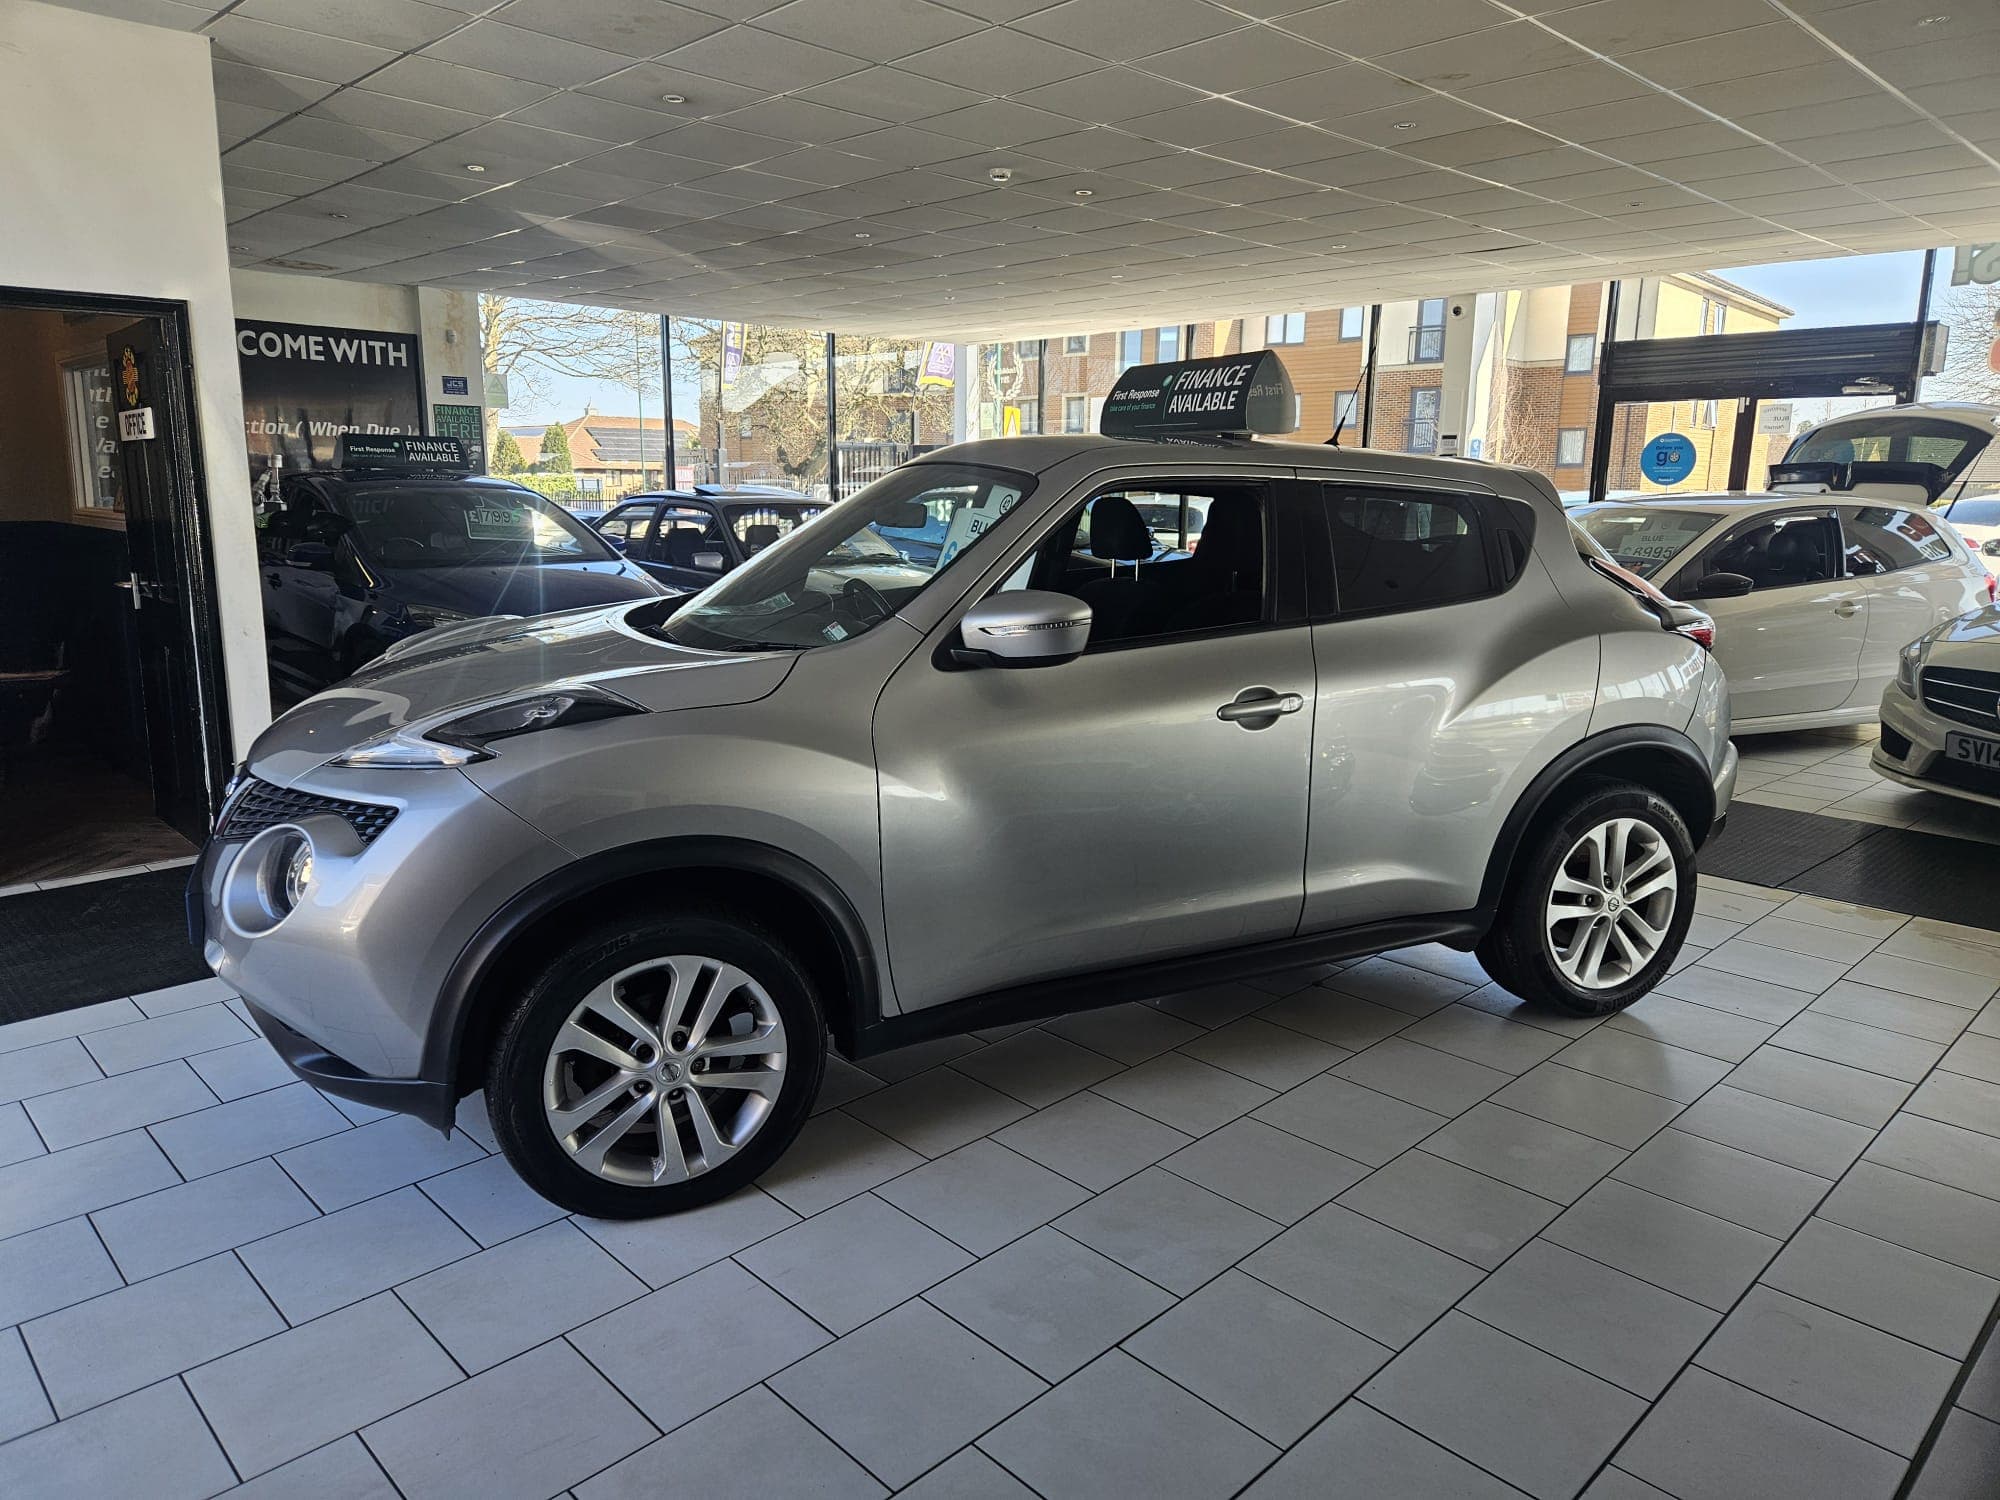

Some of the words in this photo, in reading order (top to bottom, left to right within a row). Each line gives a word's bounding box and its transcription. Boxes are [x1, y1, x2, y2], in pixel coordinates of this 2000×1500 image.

[237, 330, 325, 361] COME
[328, 337, 408, 367] WITH
[1174, 364, 1252, 391] FINANCE
[1113, 390, 1128, 401] First
[1128, 388, 1160, 401] Response
[1168, 390, 1239, 413] AVAILABLE
[435, 406, 479, 416] FINANCE
[124, 412, 147, 436] OFFICE
[435, 415, 480, 423] AVAILABLE
[310, 421, 360, 437] When
[366, 423, 401, 436] Due
[435, 423, 480, 439] HERE
[405, 441, 458, 452] FINANCE
[408, 453, 461, 463] AVAILABLE
[1641, 534, 1664, 542] BLUE
